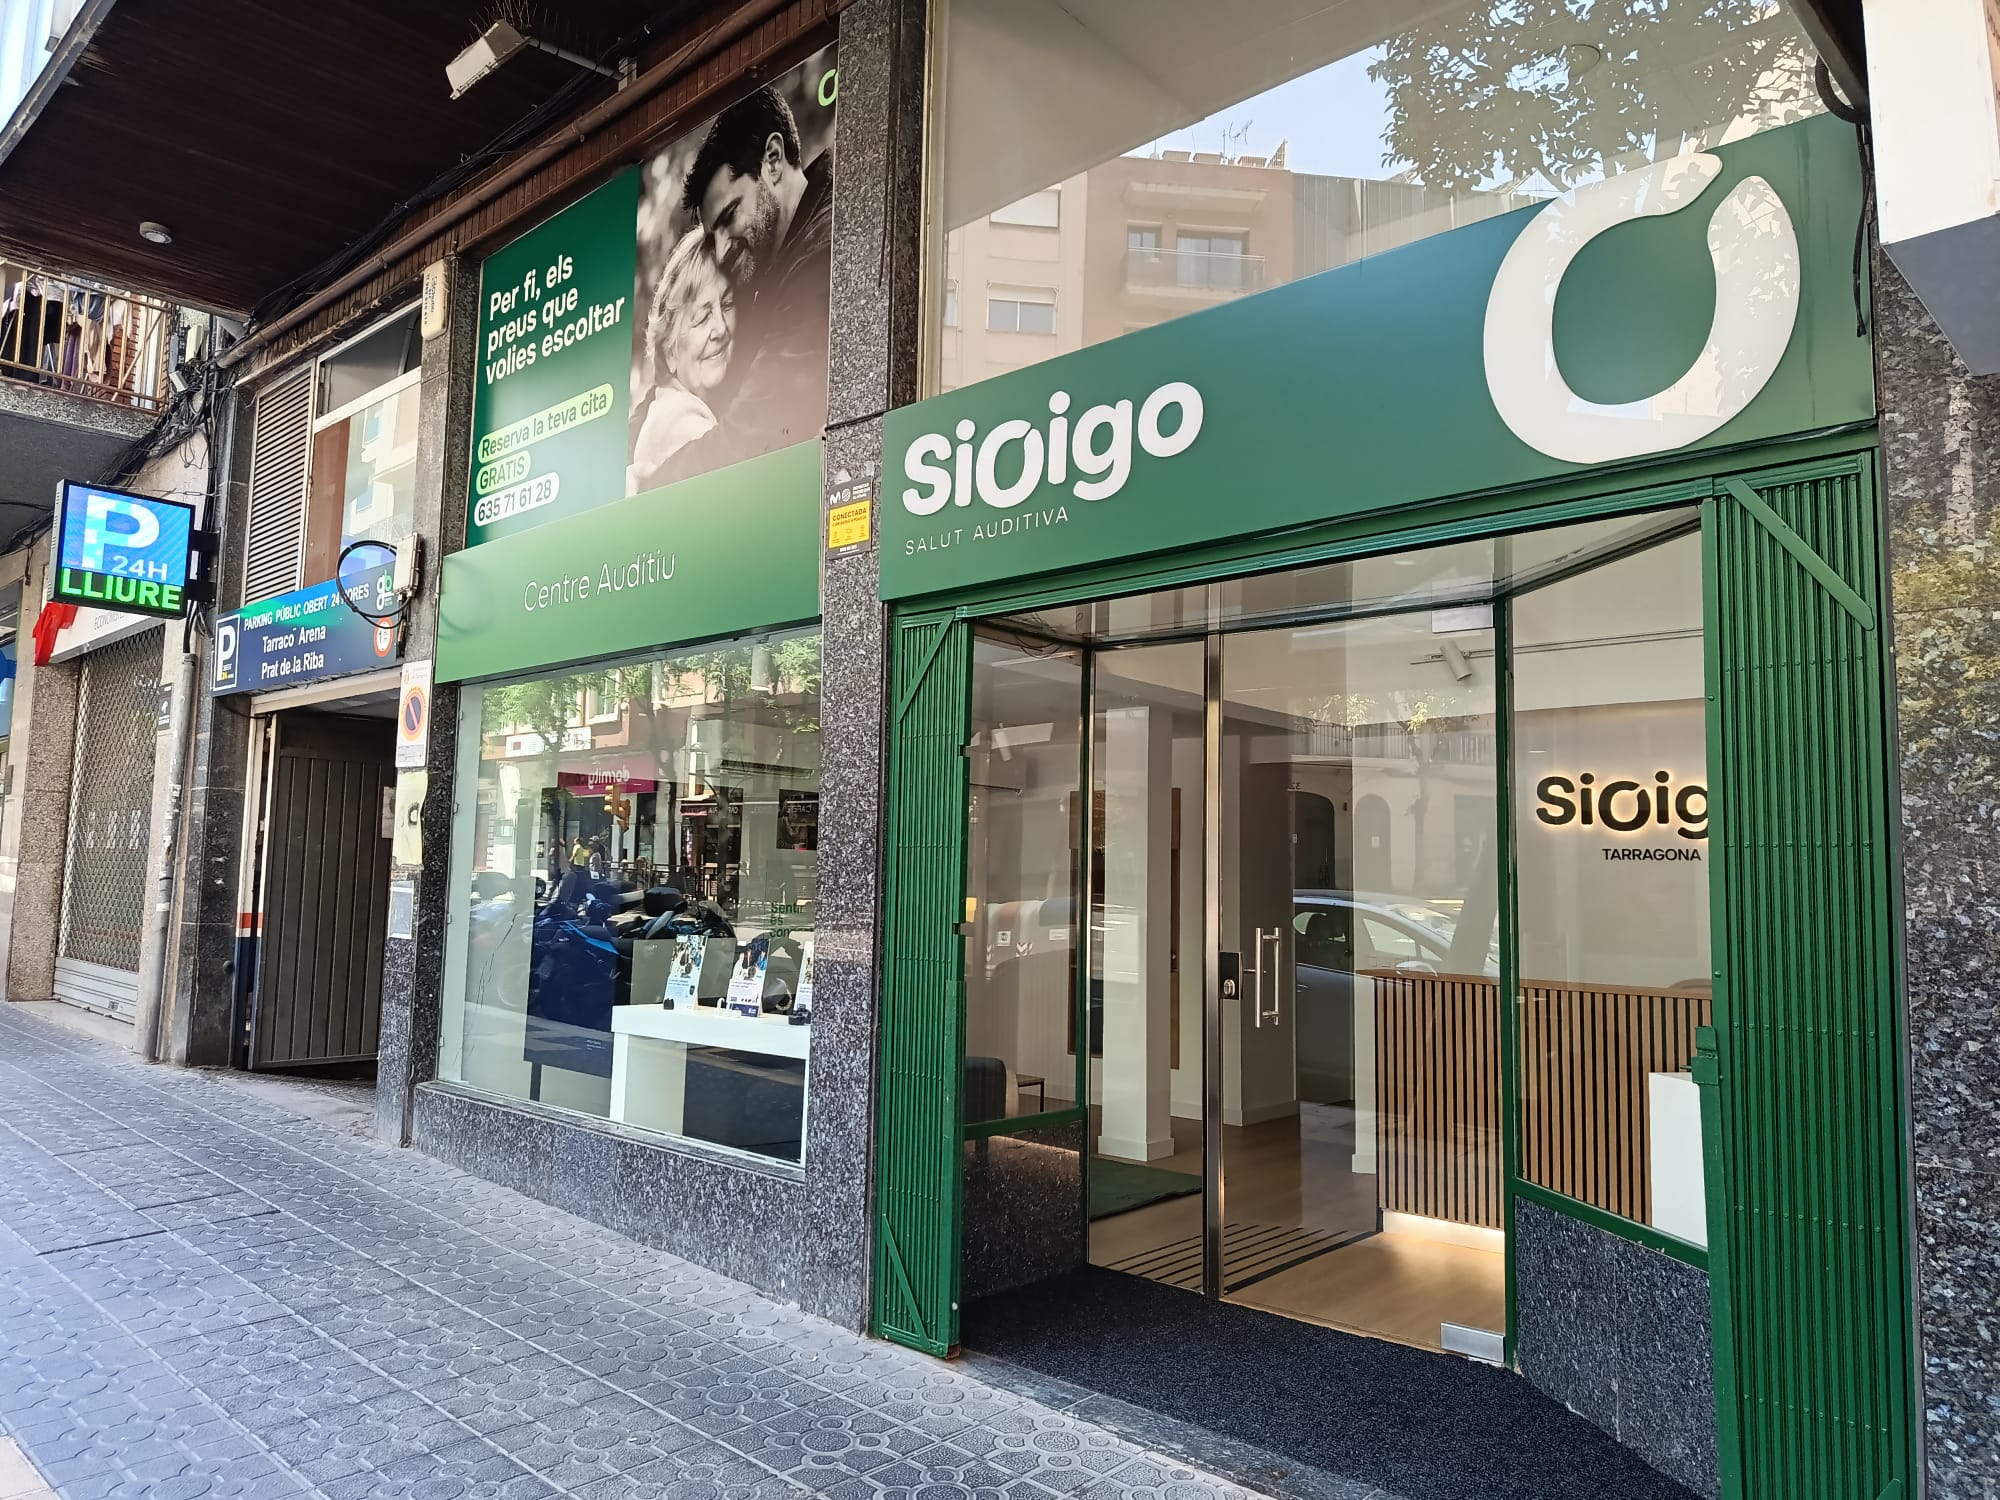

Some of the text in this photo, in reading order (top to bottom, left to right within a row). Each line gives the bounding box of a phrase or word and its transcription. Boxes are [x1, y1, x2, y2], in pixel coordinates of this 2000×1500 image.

[489, 254, 573, 321] Per fi, els
[486, 296, 625, 385] volies escoltar
[487, 287, 578, 360] preus que
[481, 392, 607, 459] Reserva la teva cita
[480, 456, 525, 490] GRATIS
[478, 478, 552, 522] 635 71 61 28
[832, 508, 867, 522] CONECTADA
[82, 494, 160, 569] P
[905, 506, 1069, 556] SALUT AUDITIVA
[61, 567, 182, 610] LLIURE
[111, 555, 168, 581] 24H
[524, 549, 675, 612] Centre Auditiu
[243, 612, 273, 632] PARKING
[275, 603, 302, 622] PÚBLIC
[303, 595, 329, 615] OBERT
[216, 625, 236, 682] P
[262, 625, 327, 653] Tarraco Arena
[261, 650, 325, 680] Prat de la Riba
[1602, 848, 1701, 861] TARRAGONA
